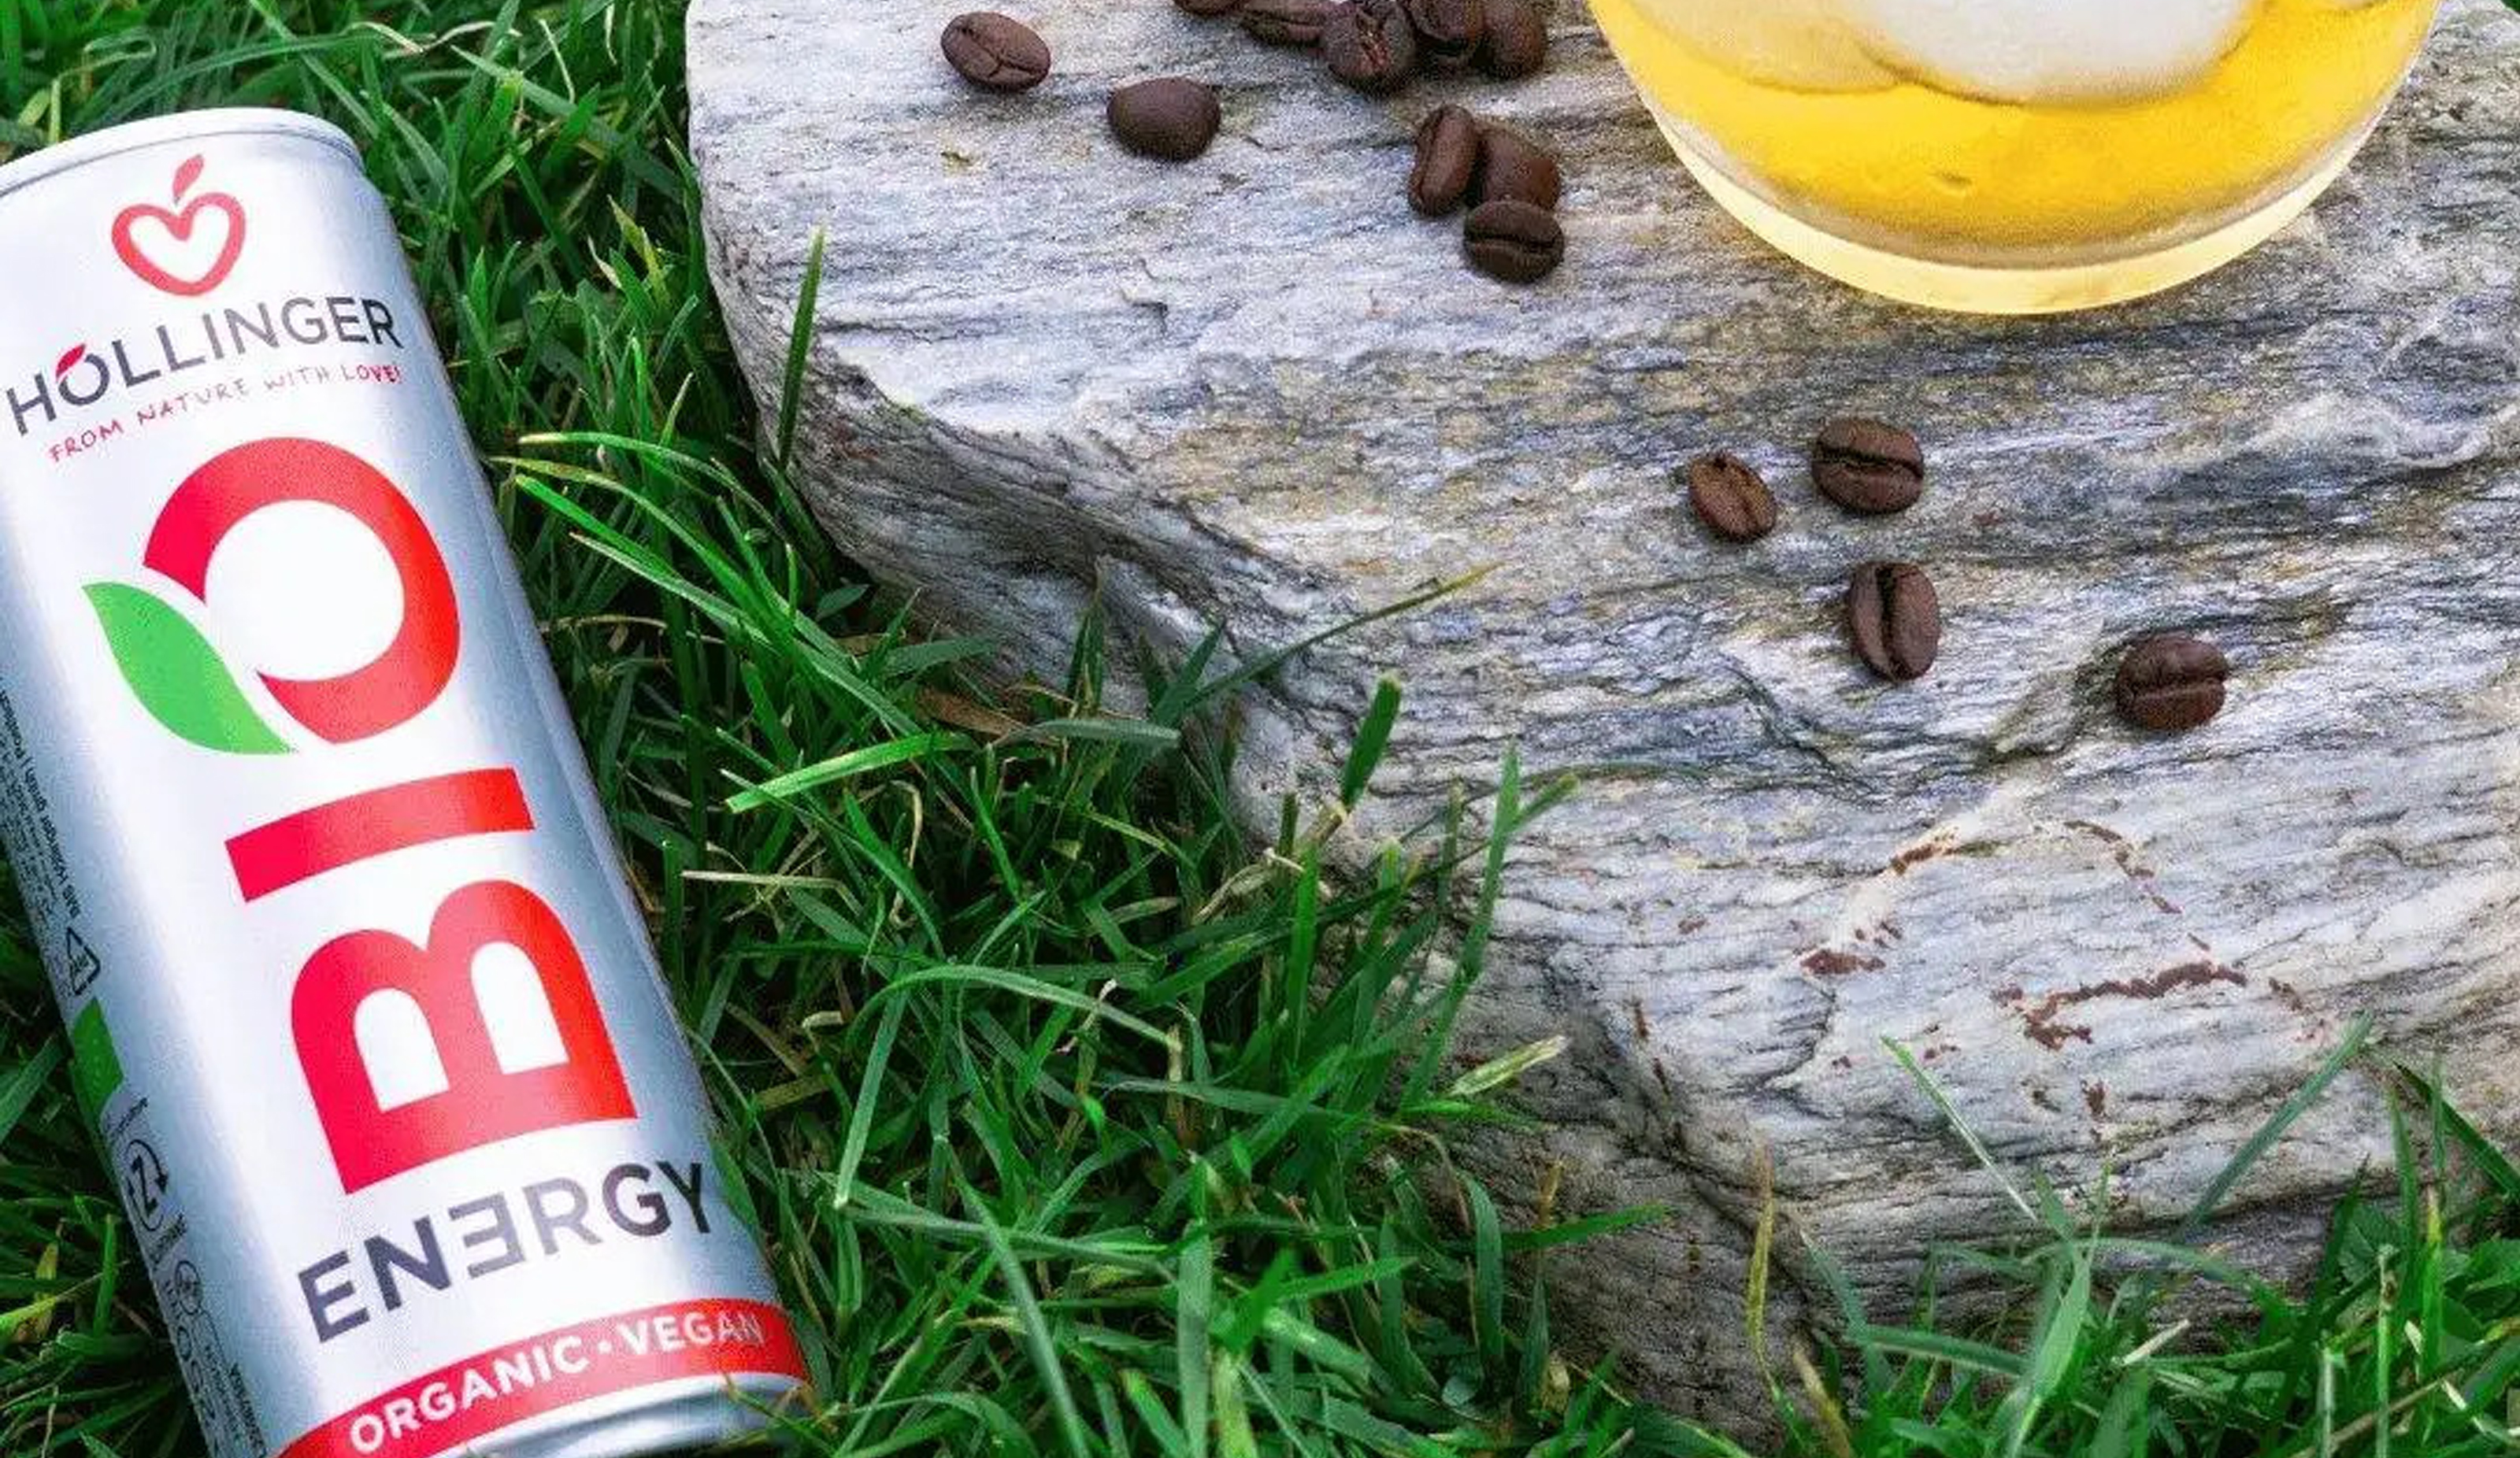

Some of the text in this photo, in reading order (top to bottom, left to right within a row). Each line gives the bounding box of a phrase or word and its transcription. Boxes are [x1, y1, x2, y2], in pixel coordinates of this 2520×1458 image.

[49, 364, 402, 464] FROM NATURE WITH LOVE!
[349, 1336, 592, 1453] ORGANIC
[616, 1310, 765, 1356] VEGAN
